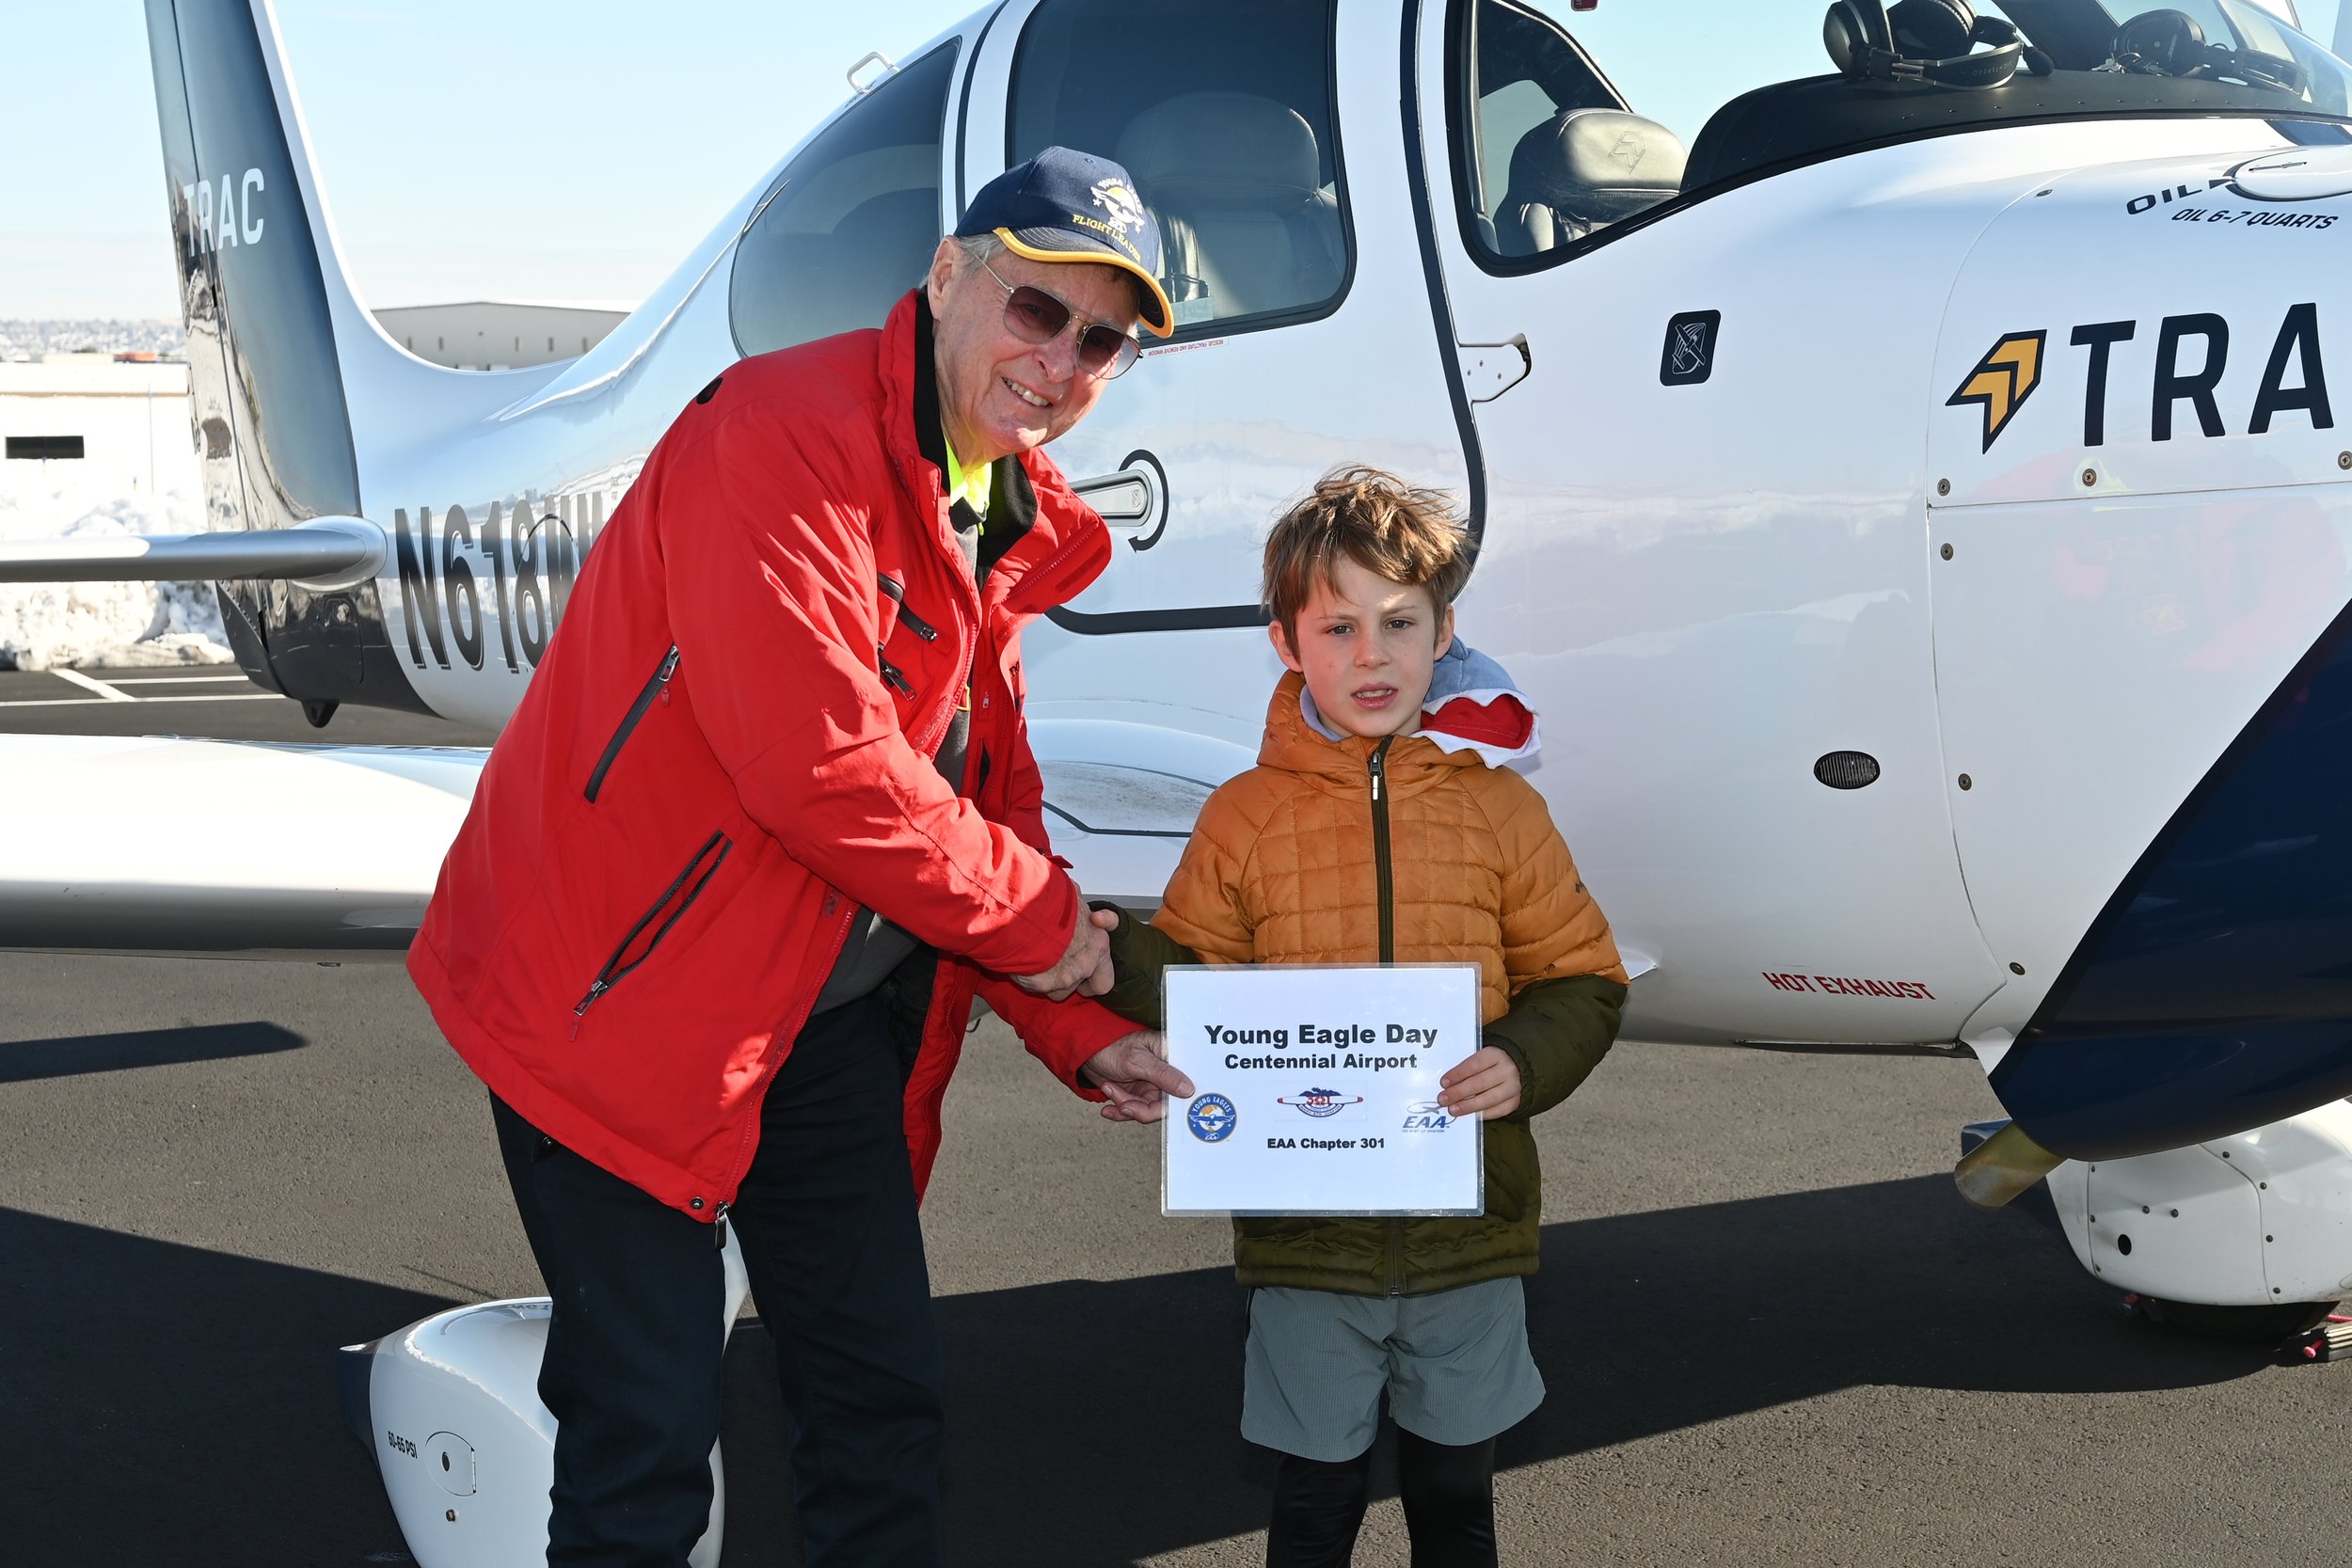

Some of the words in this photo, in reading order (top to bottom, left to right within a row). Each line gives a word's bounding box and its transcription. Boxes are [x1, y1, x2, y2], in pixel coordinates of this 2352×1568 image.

[2126, 184, 2202, 214] OIL
[183, 167, 264, 257] TRAC
[2171, 209, 2208, 222] OIL
[2207, 210, 2252, 224] 6-7
[2246, 211, 2340, 230] QUARTS
[1072, 214, 1113, 235] FLIGHT
[2070, 302, 2334, 447] TRA
[1761, 972, 1818, 993] HOT
[1813, 975, 1937, 1001] EXHAUST
[1203, 1024, 1288, 1050] Young
[1298, 1023, 1376, 1050] Eagle
[1386, 1023, 1438, 1049] Day
[1224, 1053, 1336, 1069] Centennial
[1343, 1053, 1417, 1072] Airport
[1191, 1096, 1211, 1113] YOUNG
[1213, 1096, 1232, 1113] EAGLES
[1403, 1116, 1446, 1129] EAA
[1267, 1137, 1296, 1148] EAA
[1300, 1137, 1357, 1151] Chapter
[1359, 1137, 1385, 1149] 301
[405, 1439, 418, 1460] PSI
